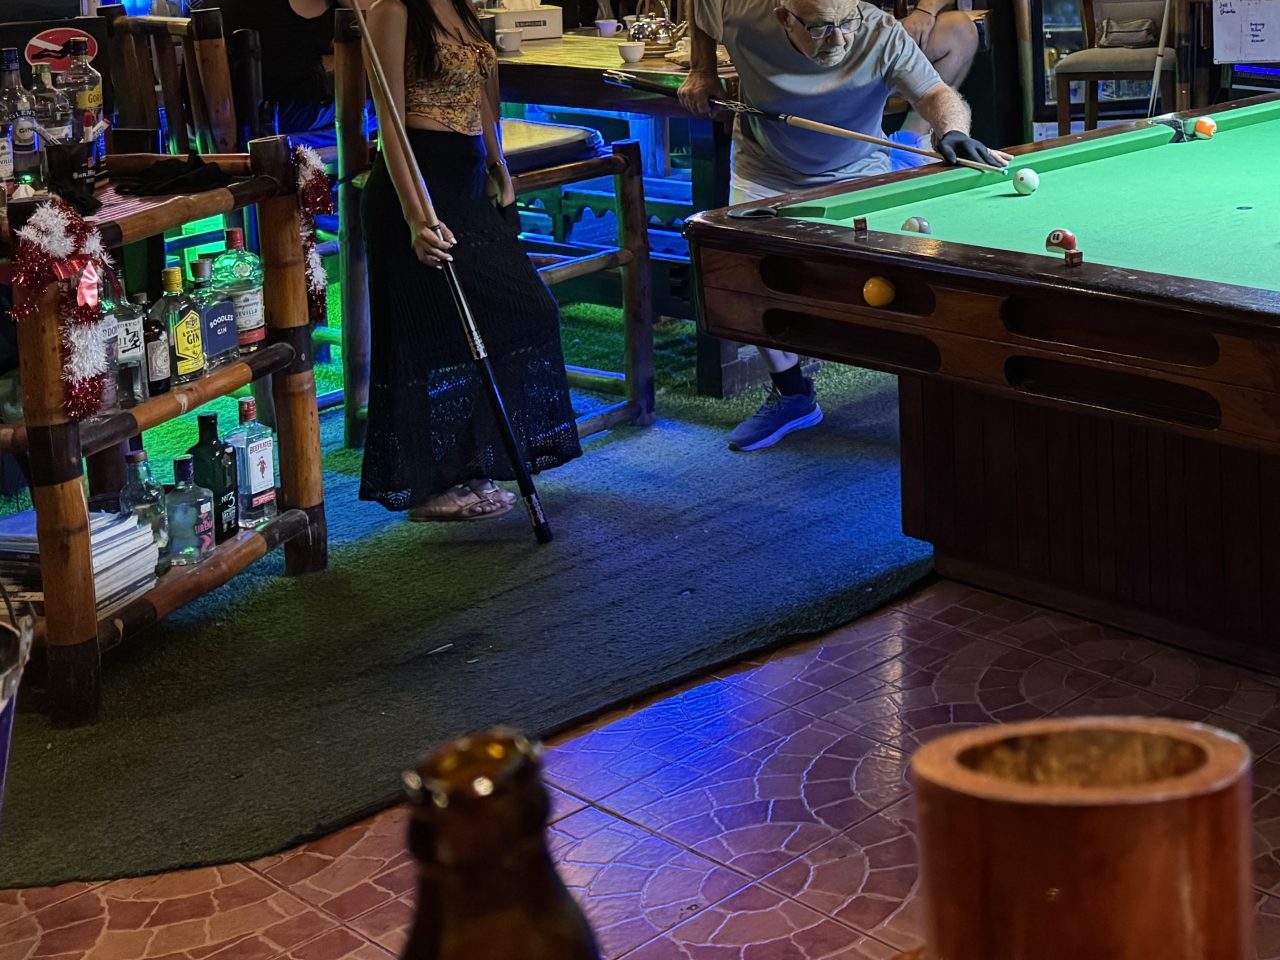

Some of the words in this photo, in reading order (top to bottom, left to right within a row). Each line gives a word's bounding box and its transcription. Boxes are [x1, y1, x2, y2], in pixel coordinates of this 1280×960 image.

[1052, 233, 1060, 241] 11
[209, 314, 234, 329] BOODLES
[216, 327, 228, 336] GIN
[186, 331, 200, 345] GIN
